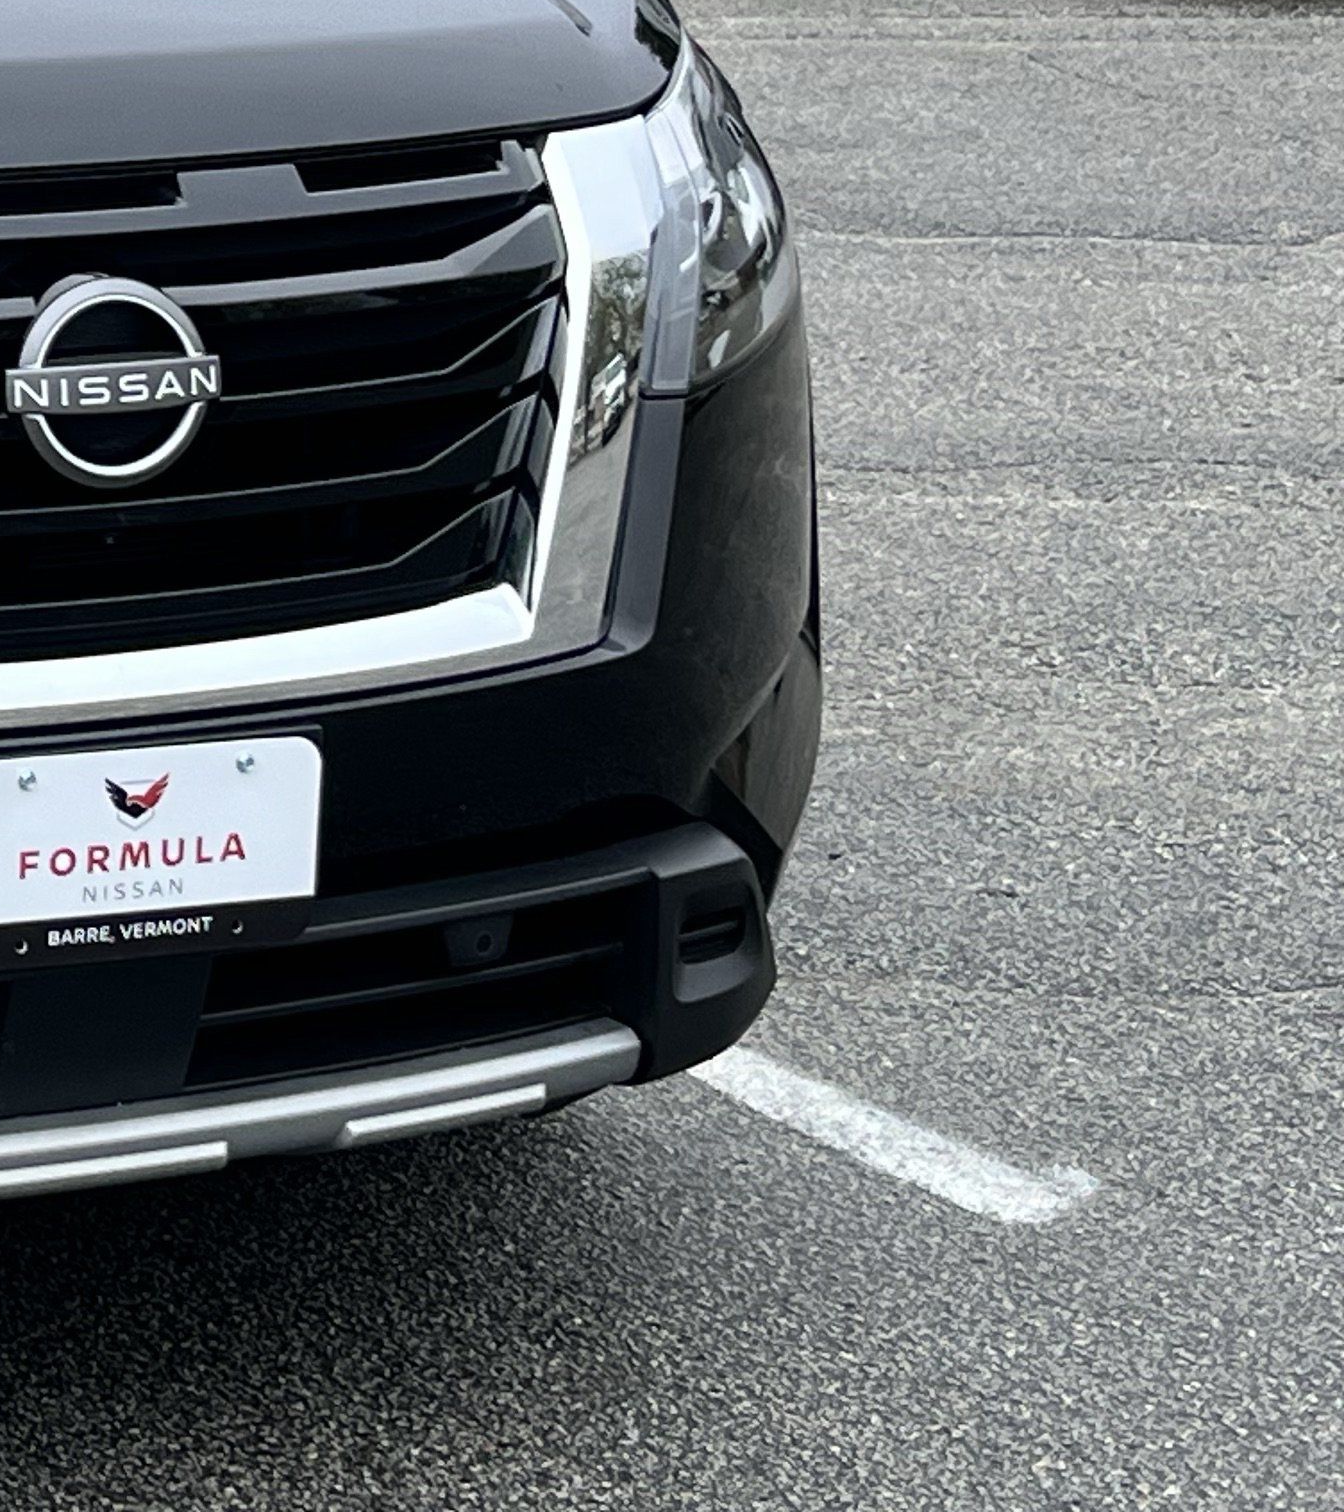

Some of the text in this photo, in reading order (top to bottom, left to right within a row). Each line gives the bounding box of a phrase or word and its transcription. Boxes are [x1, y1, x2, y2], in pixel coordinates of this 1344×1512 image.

[12, 364, 218, 408] NISSAN
[18, 832, 246, 879] FORMULA
[82, 878, 184, 903] NISSAN
[47, 915, 214, 948] BARRE, VERMONT
